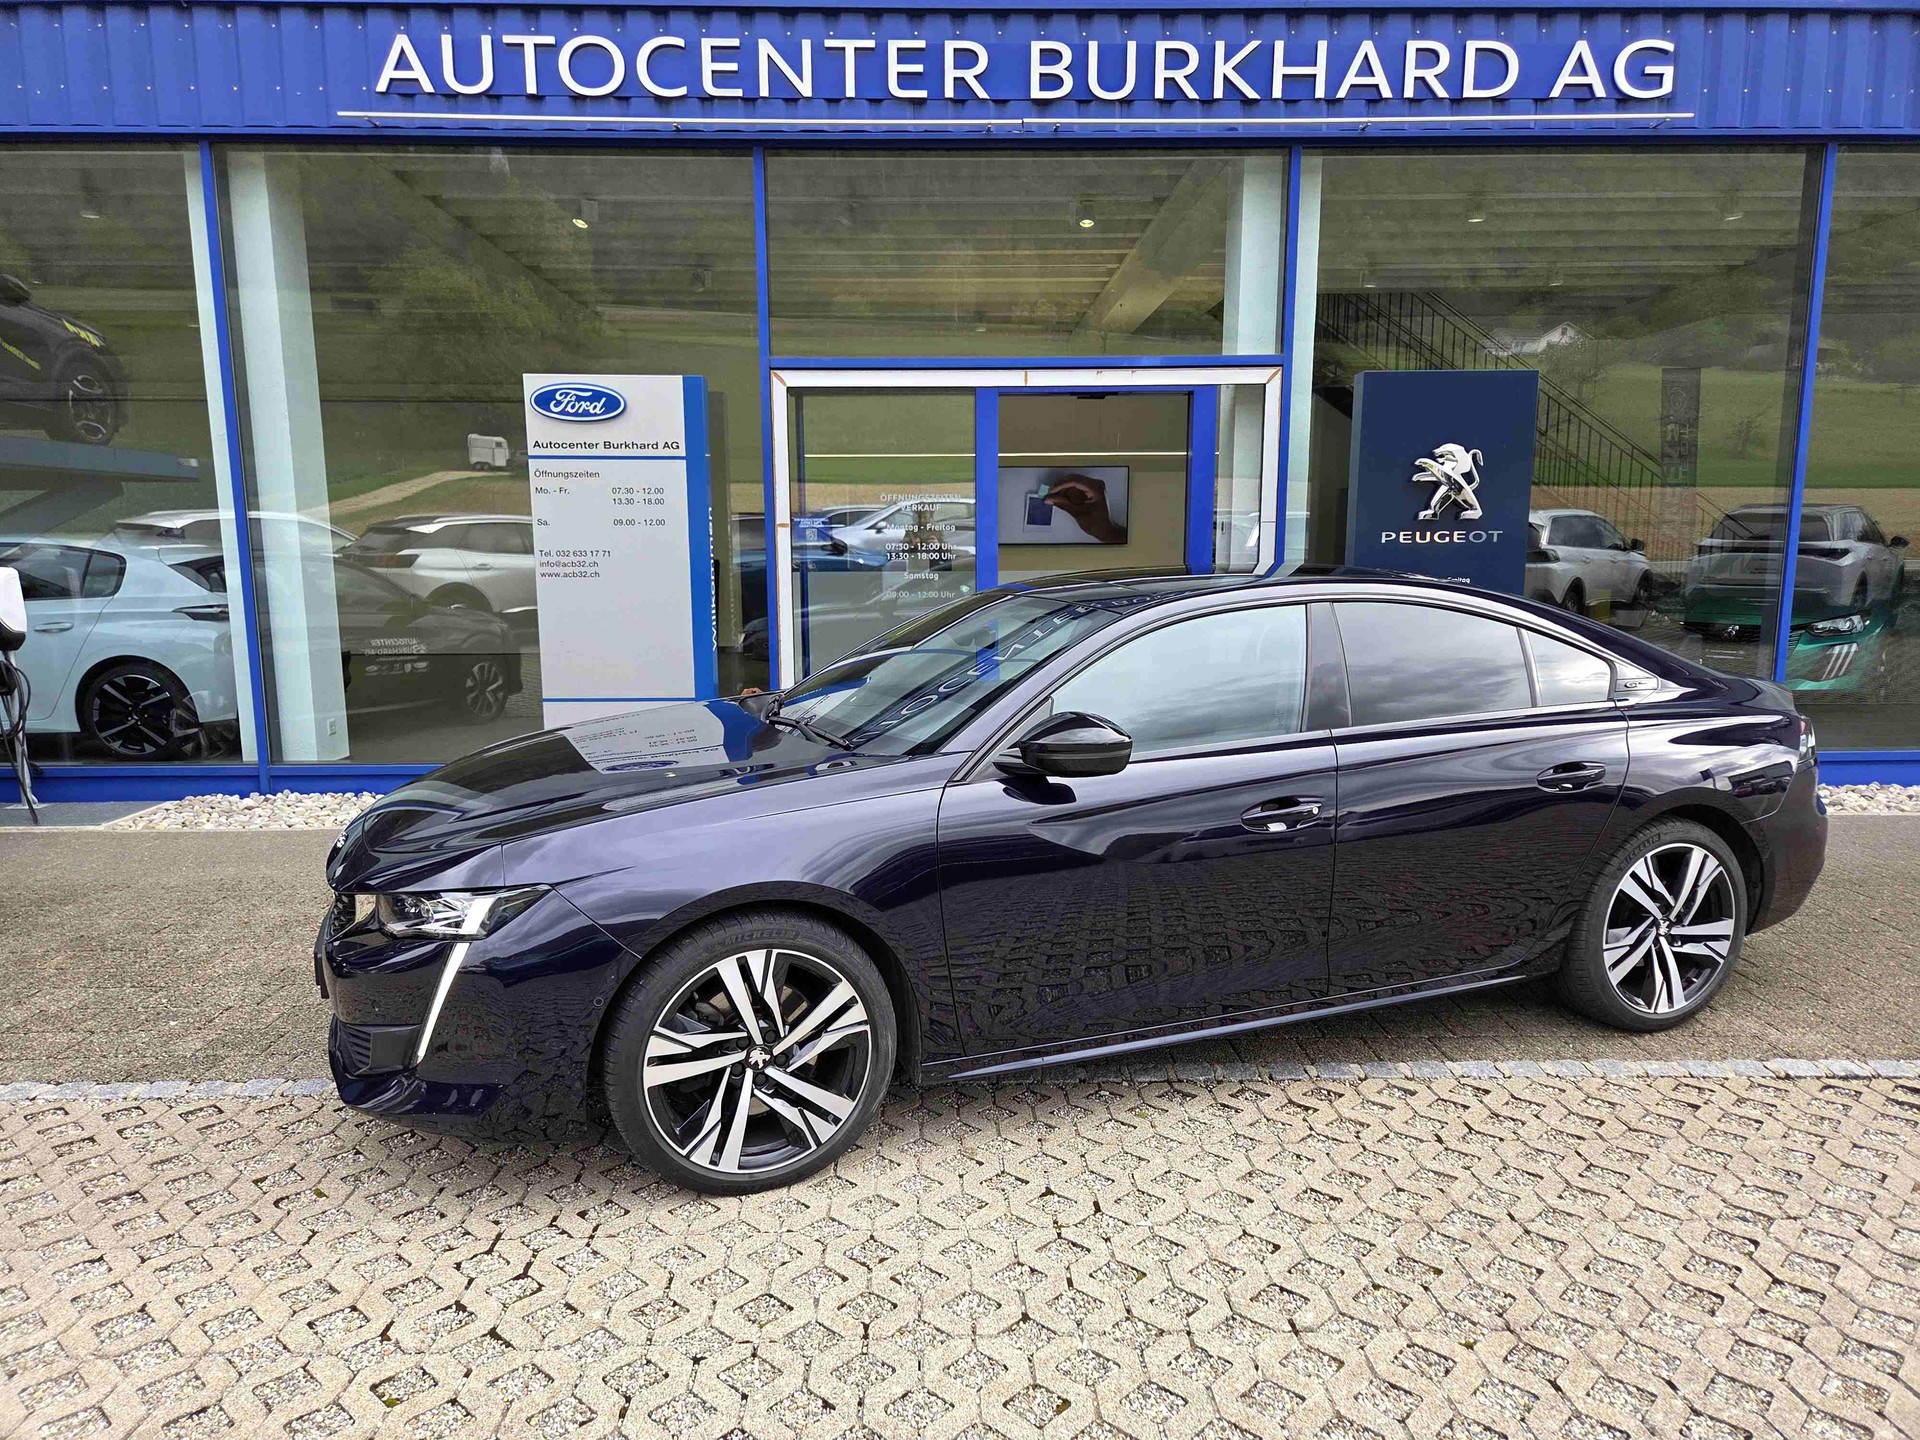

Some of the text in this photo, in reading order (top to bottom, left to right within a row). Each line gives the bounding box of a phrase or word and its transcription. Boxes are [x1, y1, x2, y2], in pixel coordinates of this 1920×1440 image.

[375, 34, 1676, 100] AUTOCENTER BURKHARD AG
[548, 388, 606, 416] Ford
[532, 439, 680, 450] Autocenter Burkhard AG
[533, 467, 601, 481] Öffnungszeiten
[534, 486, 551, 495] Mo.
[558, 486, 571, 495] Fr.
[611, 487, 635, 495] 07.30
[642, 487, 665, 495] 12.00
[612, 497, 635, 506] 13.30
[642, 497, 665, 506] 18.00
[900, 503, 942, 512] VERKAUF
[536, 518, 551, 527] Sa.
[612, 518, 636, 527] 09.00
[643, 518, 666, 527] 12.00
[926, 523, 956, 533] Freitag
[1380, 530, 1504, 544] PEUGEOT
[885, 542, 909, 551] 07:30
[917, 542, 940, 551] 12:00
[941, 542, 957, 551] Uhr
[538, 549, 611, 558] Tel. 032 633 17 71
[886, 552, 909, 560] 13:30
[917, 552, 940, 560] 18:00
[941, 552, 957, 560] Uhr
[539, 560, 599, 568] info@acb32.ch
[539, 570, 601, 578] www.acb32.ch
[904, 571, 939, 581] Samstag
[1447, 576, 1471, 584] itag
[917, 590, 939, 598] 12:00
[941, 590, 956, 598] Uhr
[725, 930, 796, 945] MICHELIN
